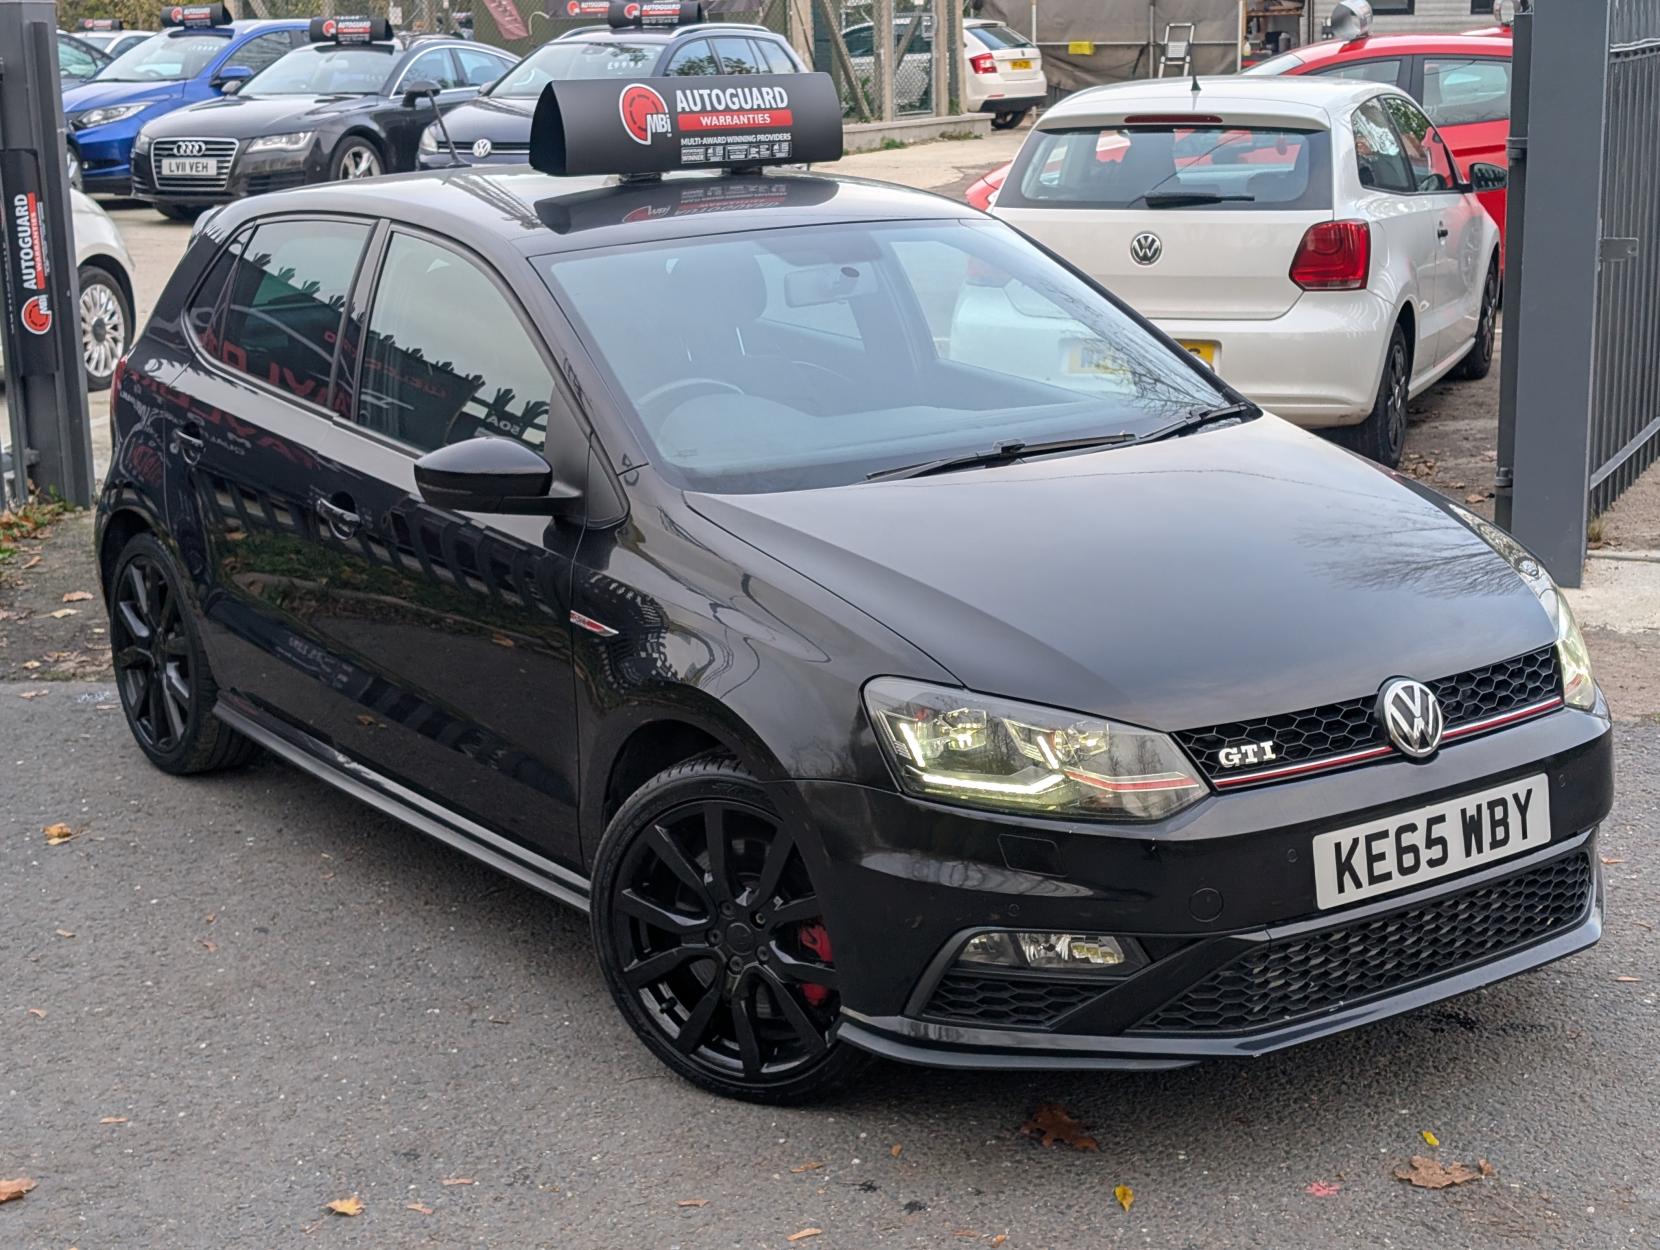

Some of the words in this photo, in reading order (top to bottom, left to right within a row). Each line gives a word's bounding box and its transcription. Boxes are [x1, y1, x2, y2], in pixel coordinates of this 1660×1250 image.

[675, 86, 789, 112] AUTOGUARD
[700, 113, 771, 127] WARRANTIES
[681, 136, 726, 146] MULTI-AWARD
[727, 134, 756, 143] WINNING
[757, 132, 792, 142] PROVIDERS
[189, 161, 208, 173] VEH
[14, 193, 38, 290] AUTOGUARD
[1218, 740, 1276, 768] GTI
[1333, 813, 1449, 895] KE65
[1460, 787, 1533, 859] WBY
